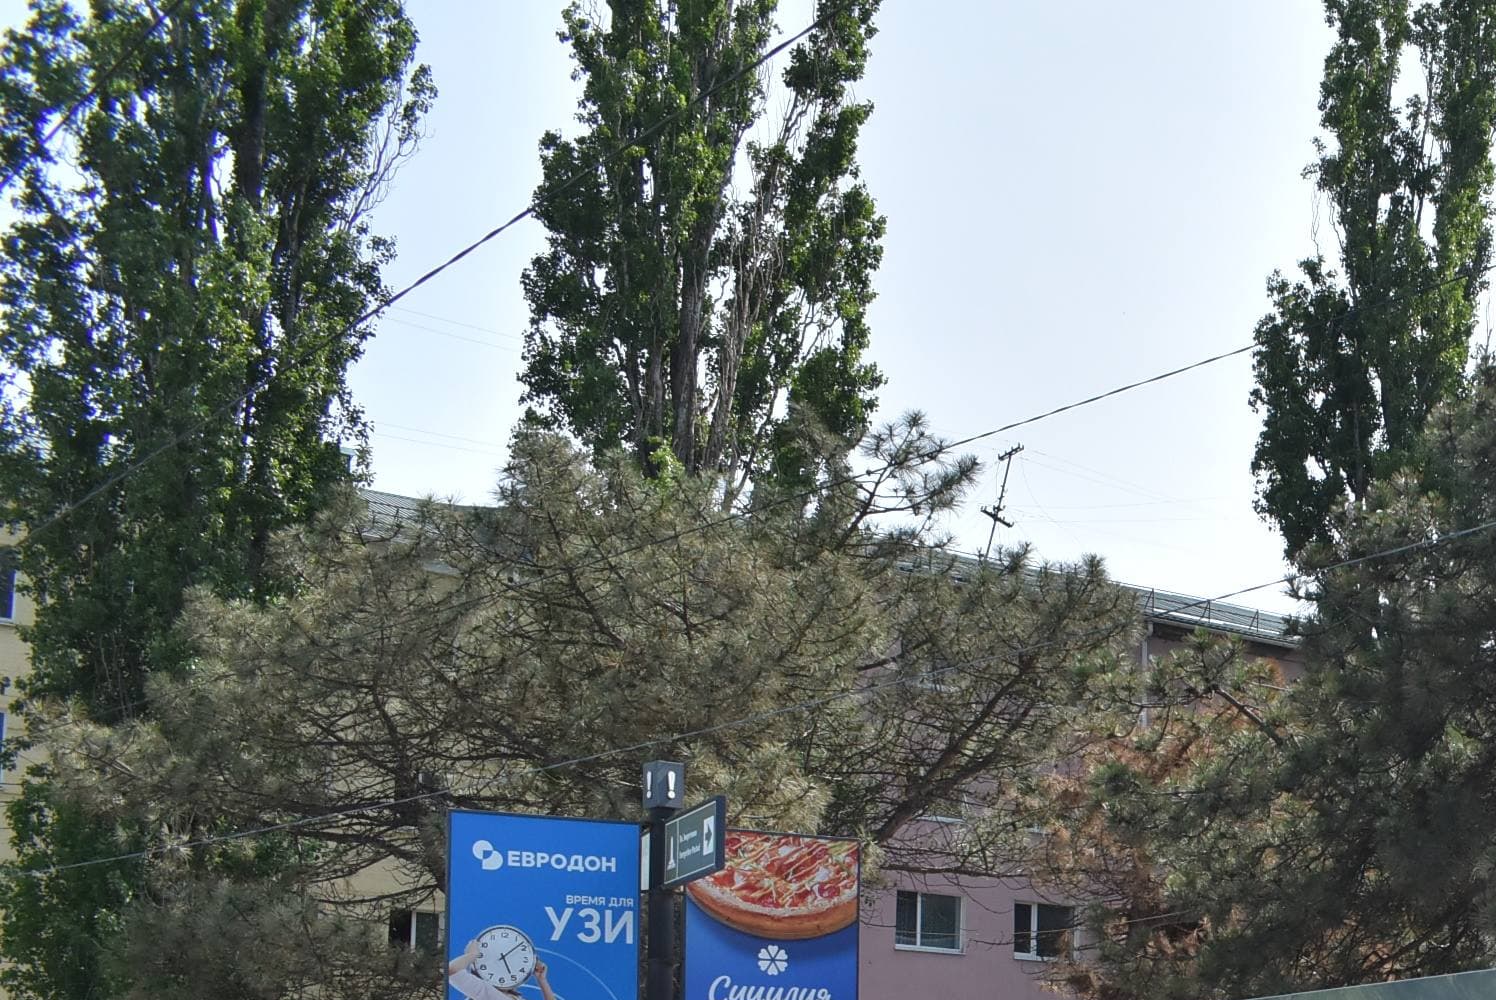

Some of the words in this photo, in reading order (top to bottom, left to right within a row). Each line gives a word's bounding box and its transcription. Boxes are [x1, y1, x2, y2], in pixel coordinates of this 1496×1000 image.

[507, 850, 616, 872] ЕВРОДОН
[566, 895, 606, 906] ВРЕМЯ
[608, 897, 634, 907] ДЛЯ
[544, 906, 634, 945] УЗИ
